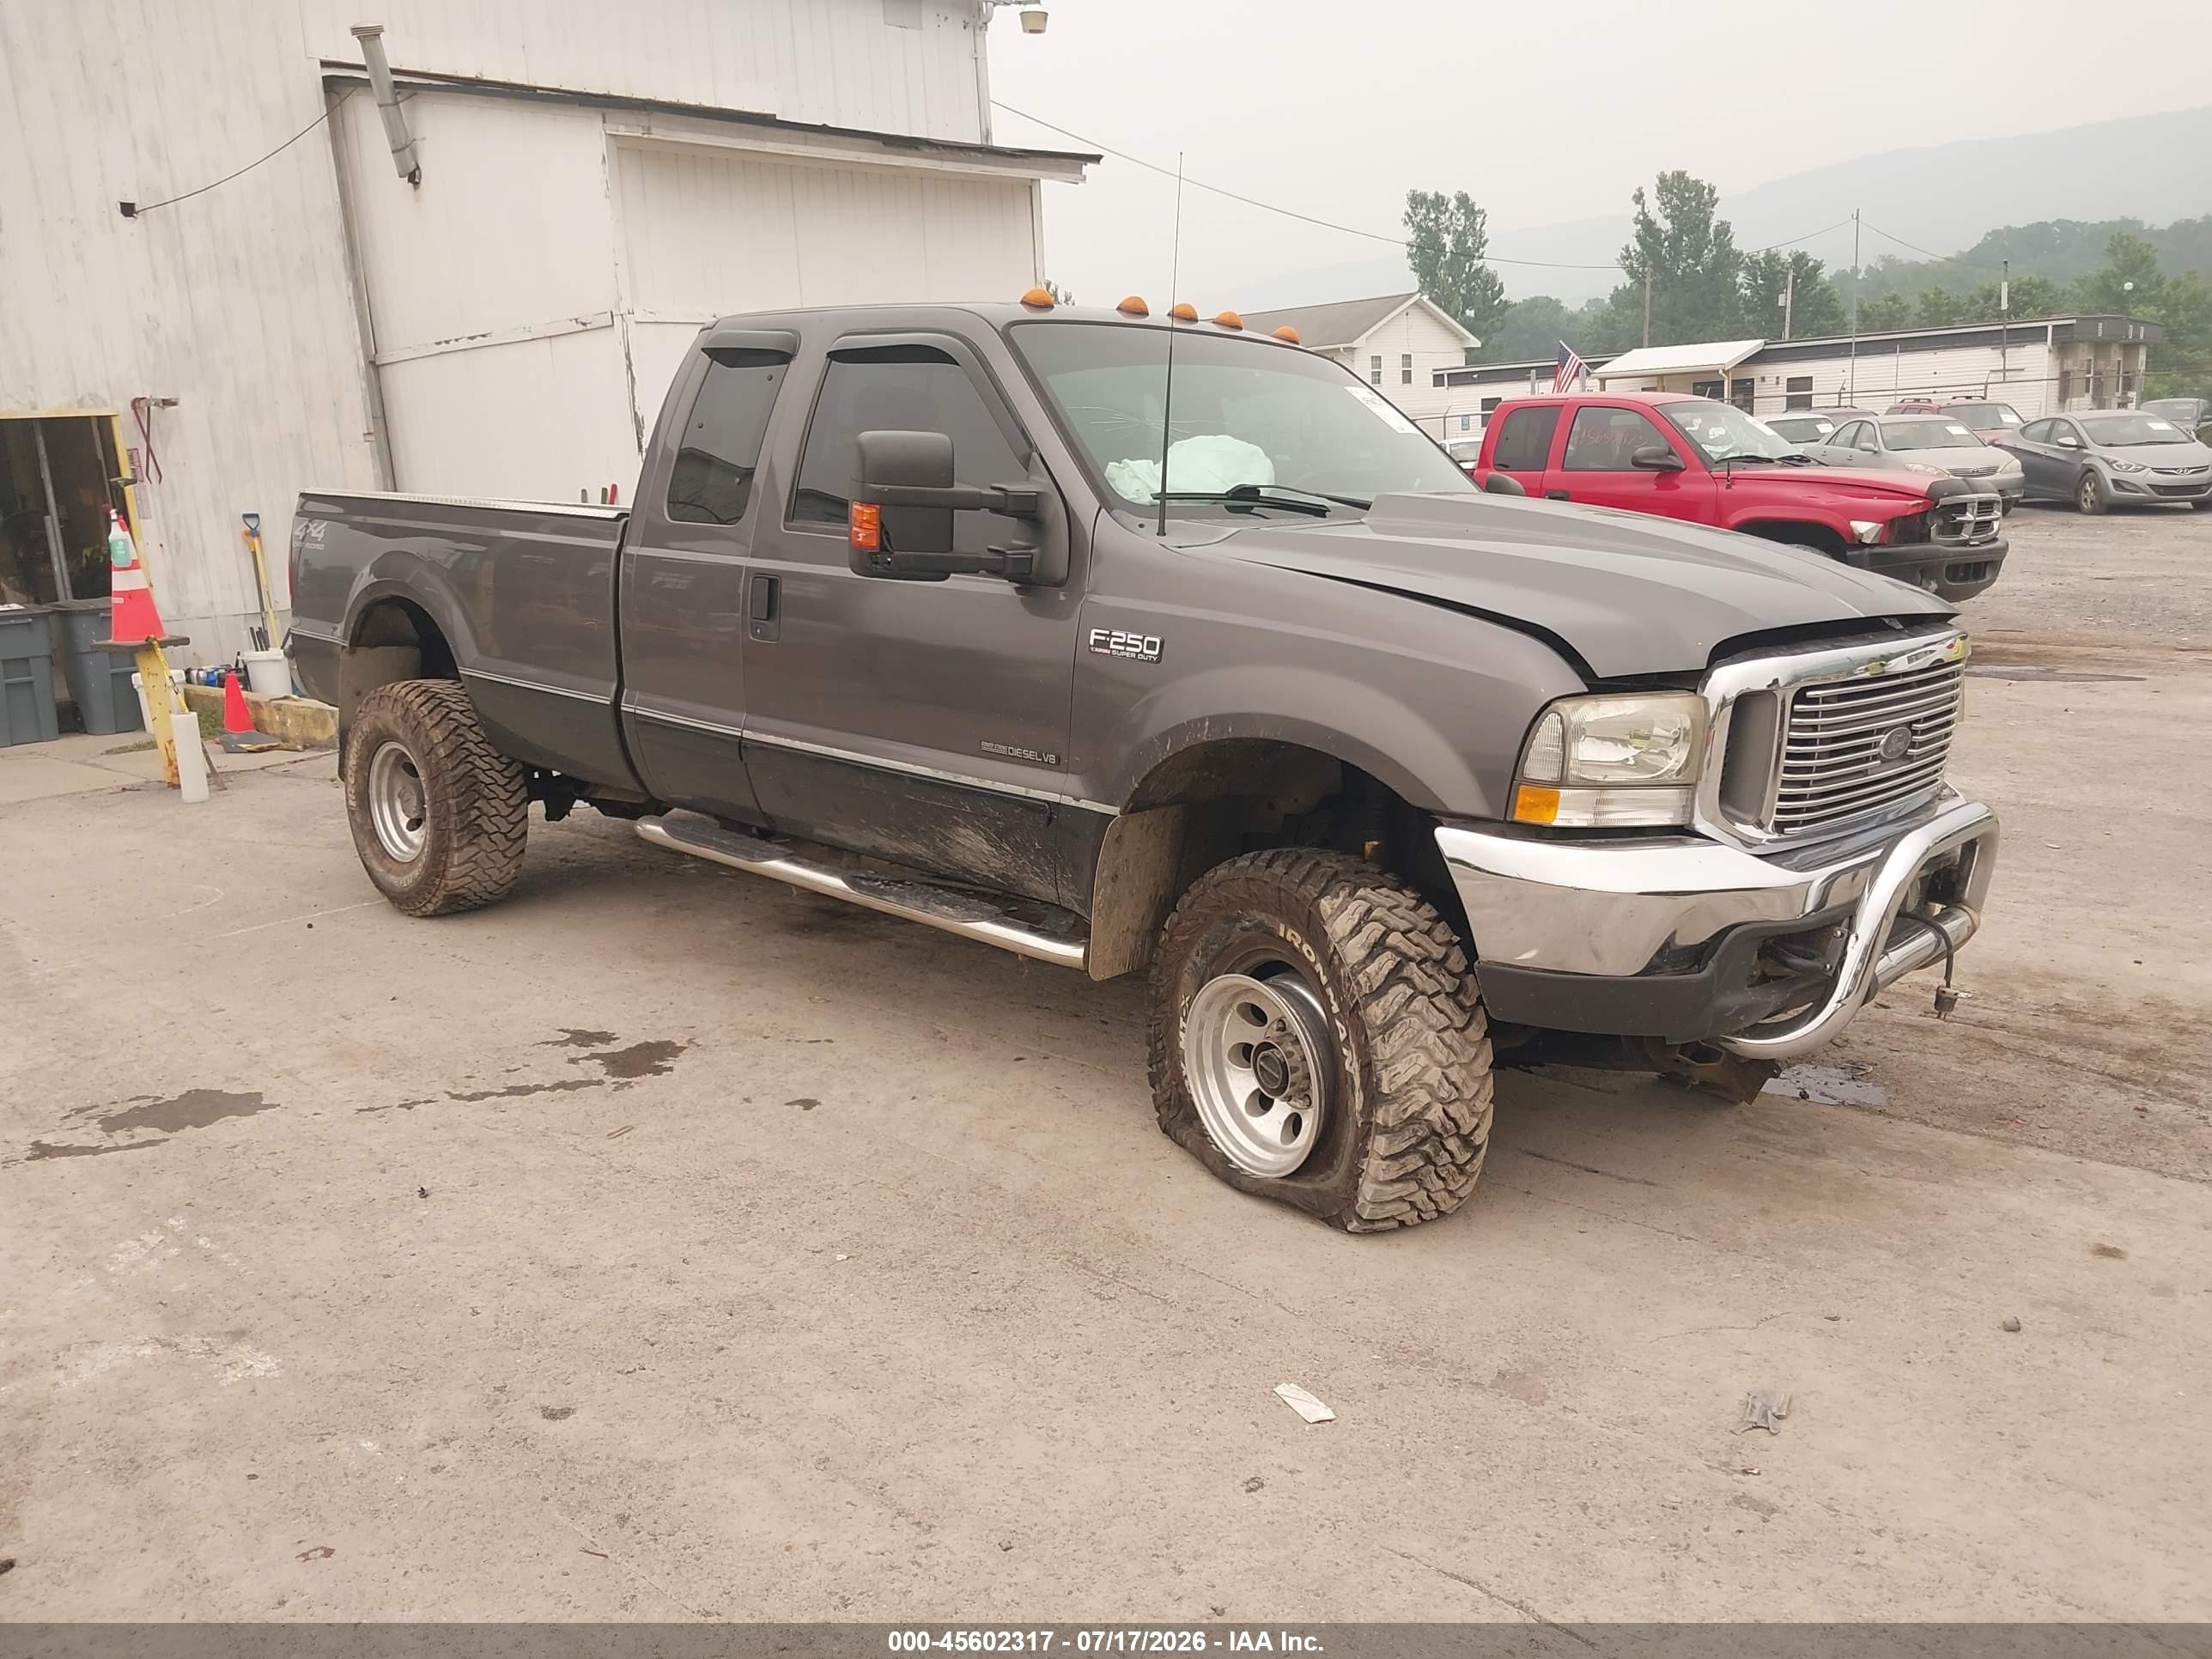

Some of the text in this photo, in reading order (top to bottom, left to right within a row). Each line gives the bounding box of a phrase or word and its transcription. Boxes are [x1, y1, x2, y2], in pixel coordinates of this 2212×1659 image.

[1112, 649, 1136, 659] SUPER
[1007, 746, 1042, 762] DIESEL
[1042, 752, 1056, 764] V8
